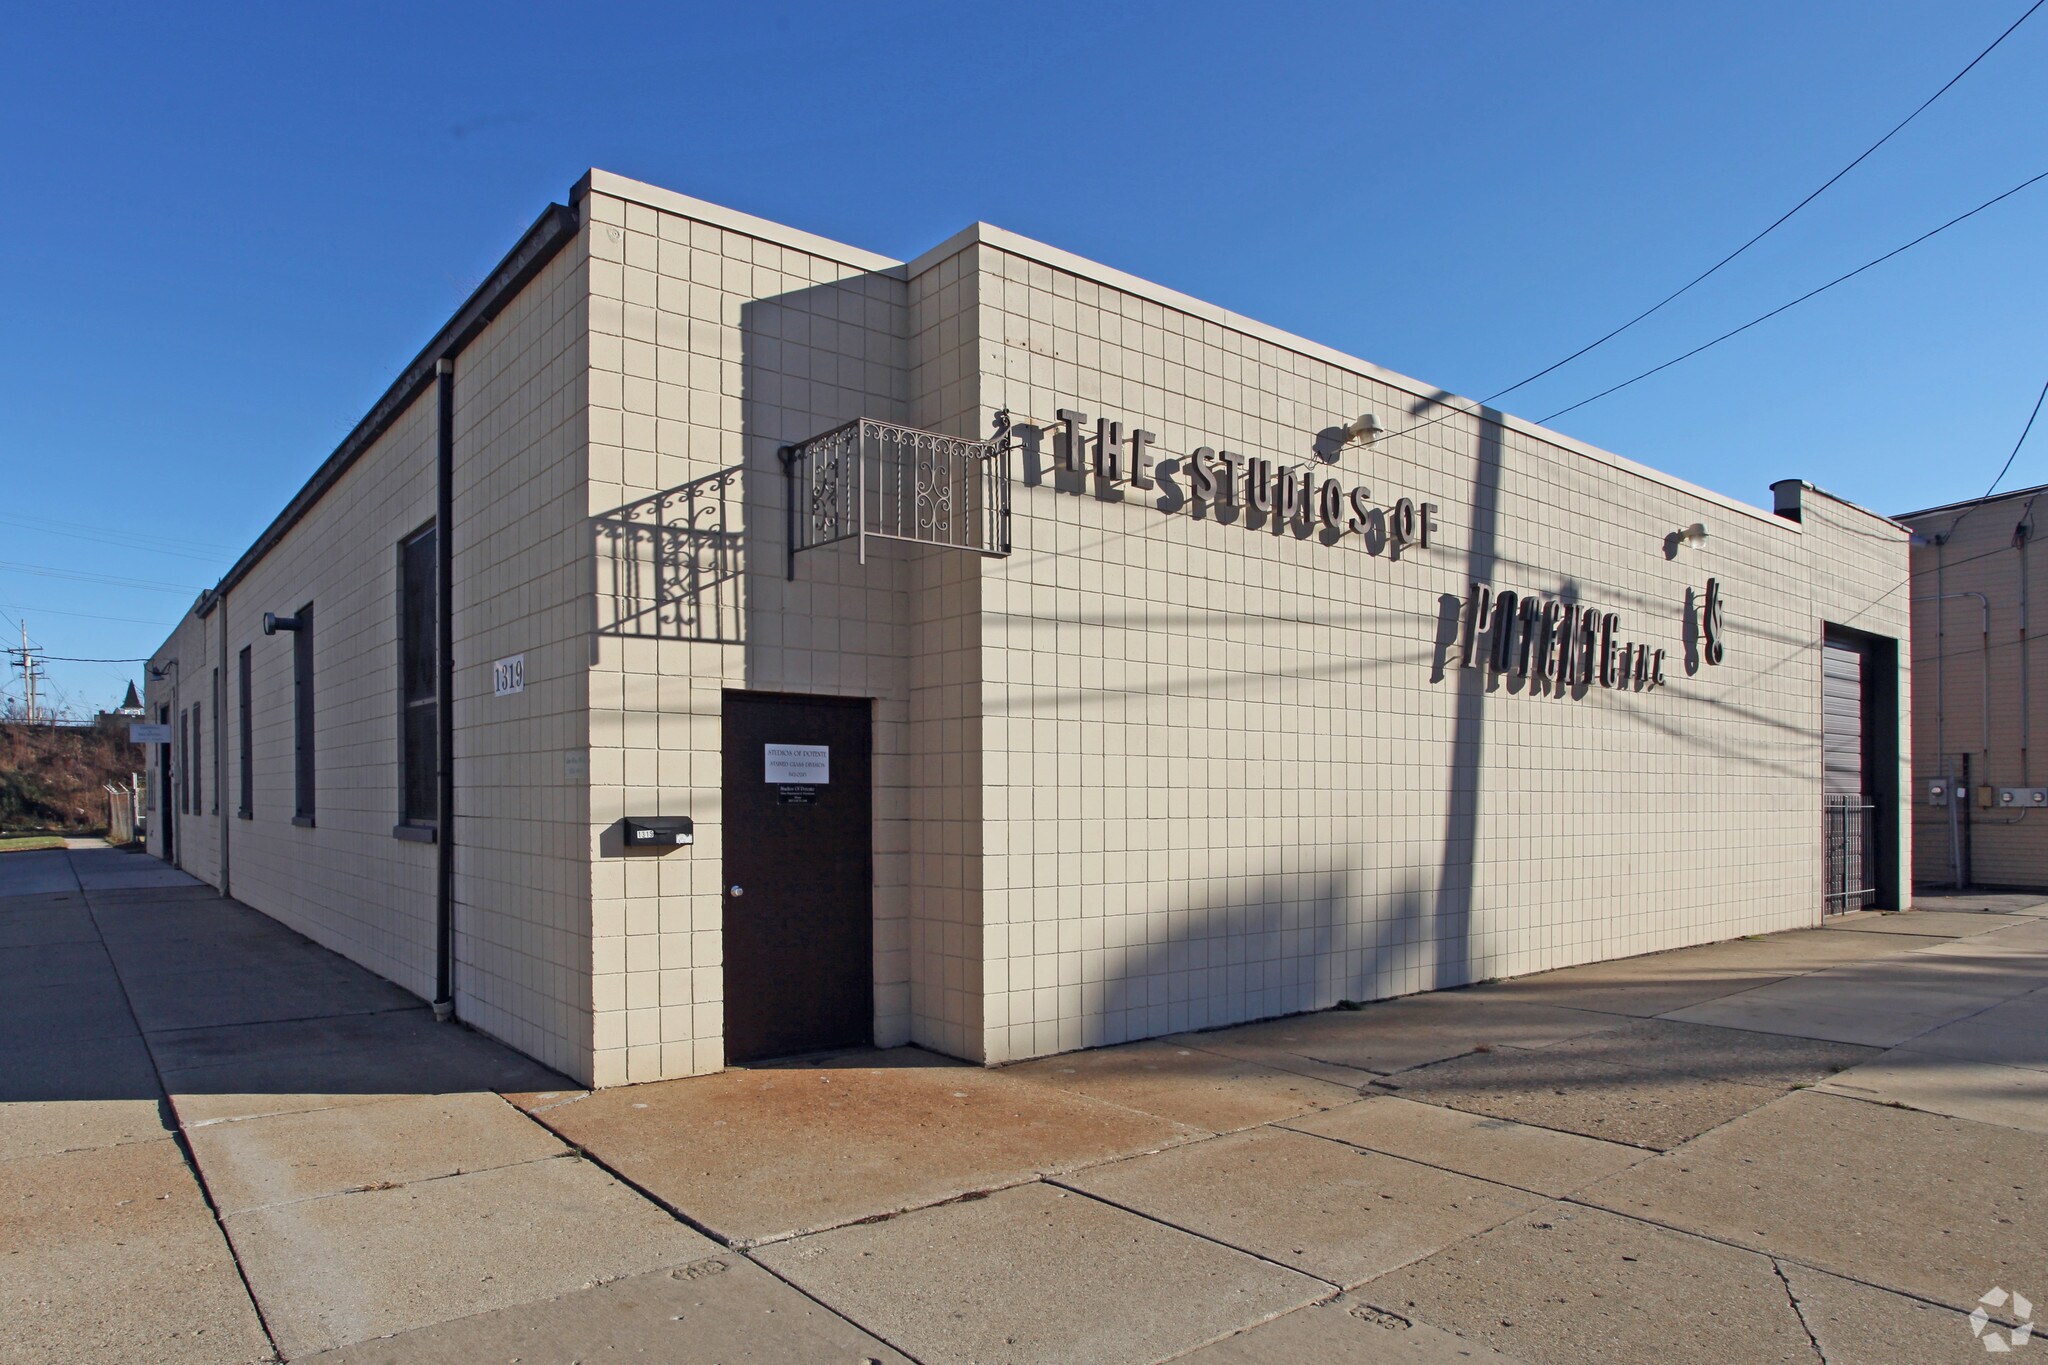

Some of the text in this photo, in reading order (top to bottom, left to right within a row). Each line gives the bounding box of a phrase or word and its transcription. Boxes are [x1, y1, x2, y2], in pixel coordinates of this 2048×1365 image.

[1056, 408, 1438, 549] THE STUDIOS OF
[1460, 582, 1666, 688] POTENTE INC
[495, 660, 522, 692] 1319
[768, 749, 792, 757] STUDIOS
